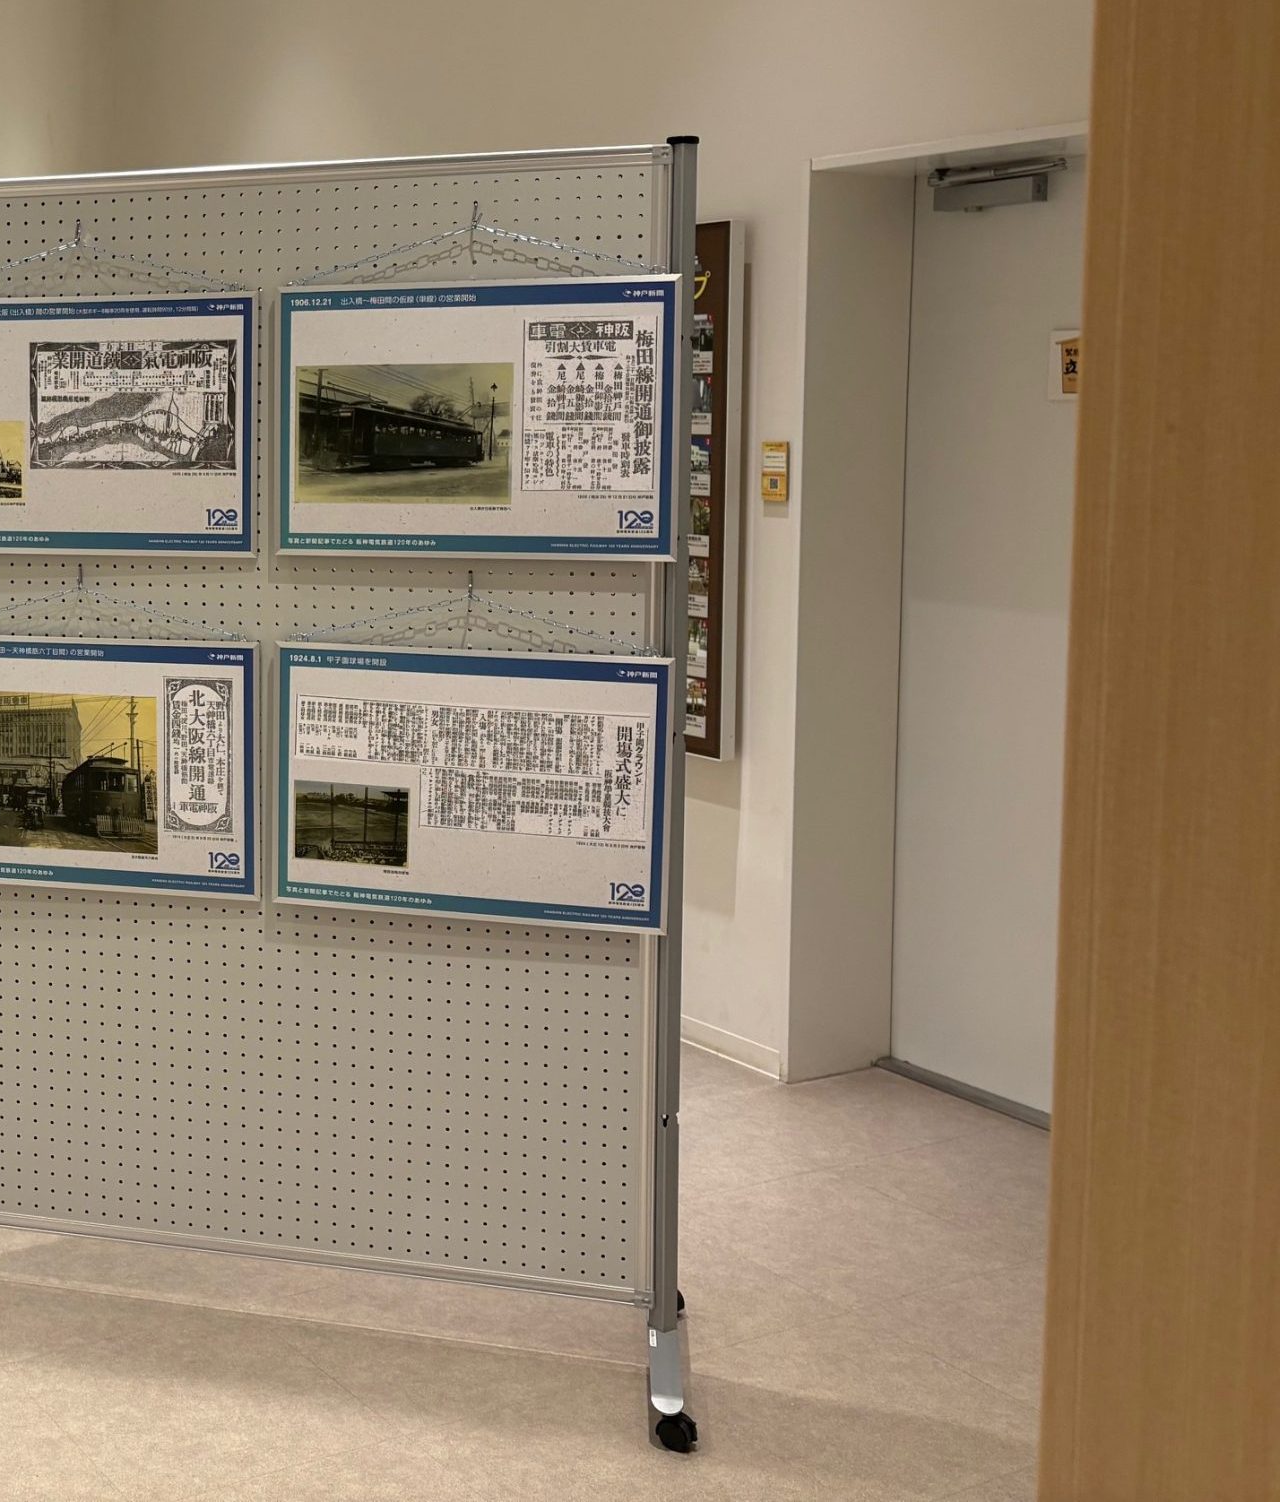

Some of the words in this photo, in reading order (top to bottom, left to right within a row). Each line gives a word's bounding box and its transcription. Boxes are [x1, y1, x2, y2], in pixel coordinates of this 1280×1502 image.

[290, 298, 332, 307] 1906.12.21
[633, 330, 655, 475] 梅田線開通御披露
[618, 510, 654, 529] 120
[289, 654, 322, 663] 1924.8.1
[188, 689, 207, 801] 北大阪線開通
[609, 882, 645, 902] 120
